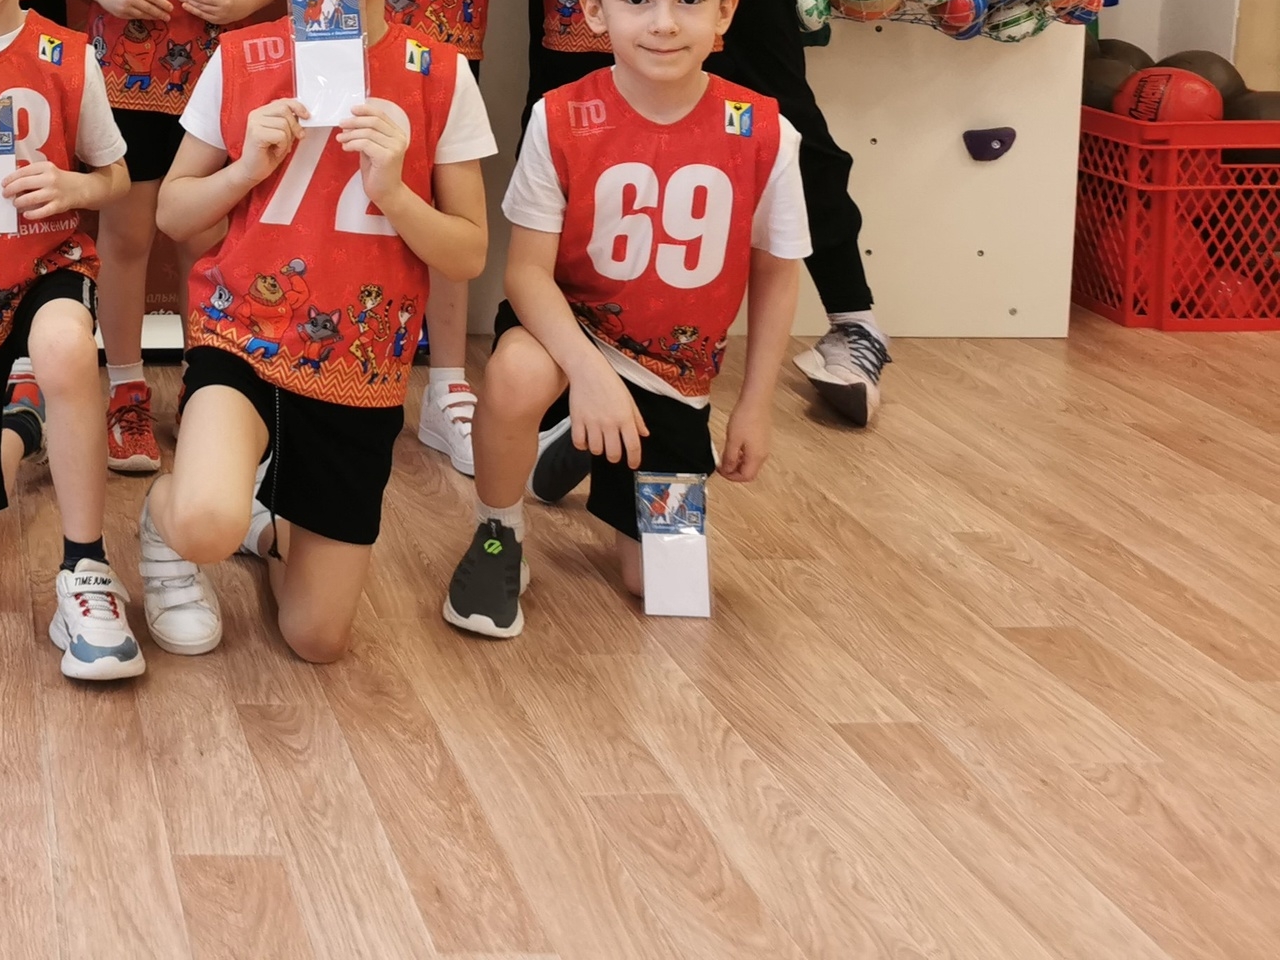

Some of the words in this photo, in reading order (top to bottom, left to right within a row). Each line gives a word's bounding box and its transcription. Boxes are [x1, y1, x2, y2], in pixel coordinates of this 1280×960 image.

[242, 36, 285, 63] ГТО
[568, 99, 608, 127] ГТО
[586, 161, 734, 289] 69
[74, 576, 93, 586] TIME
